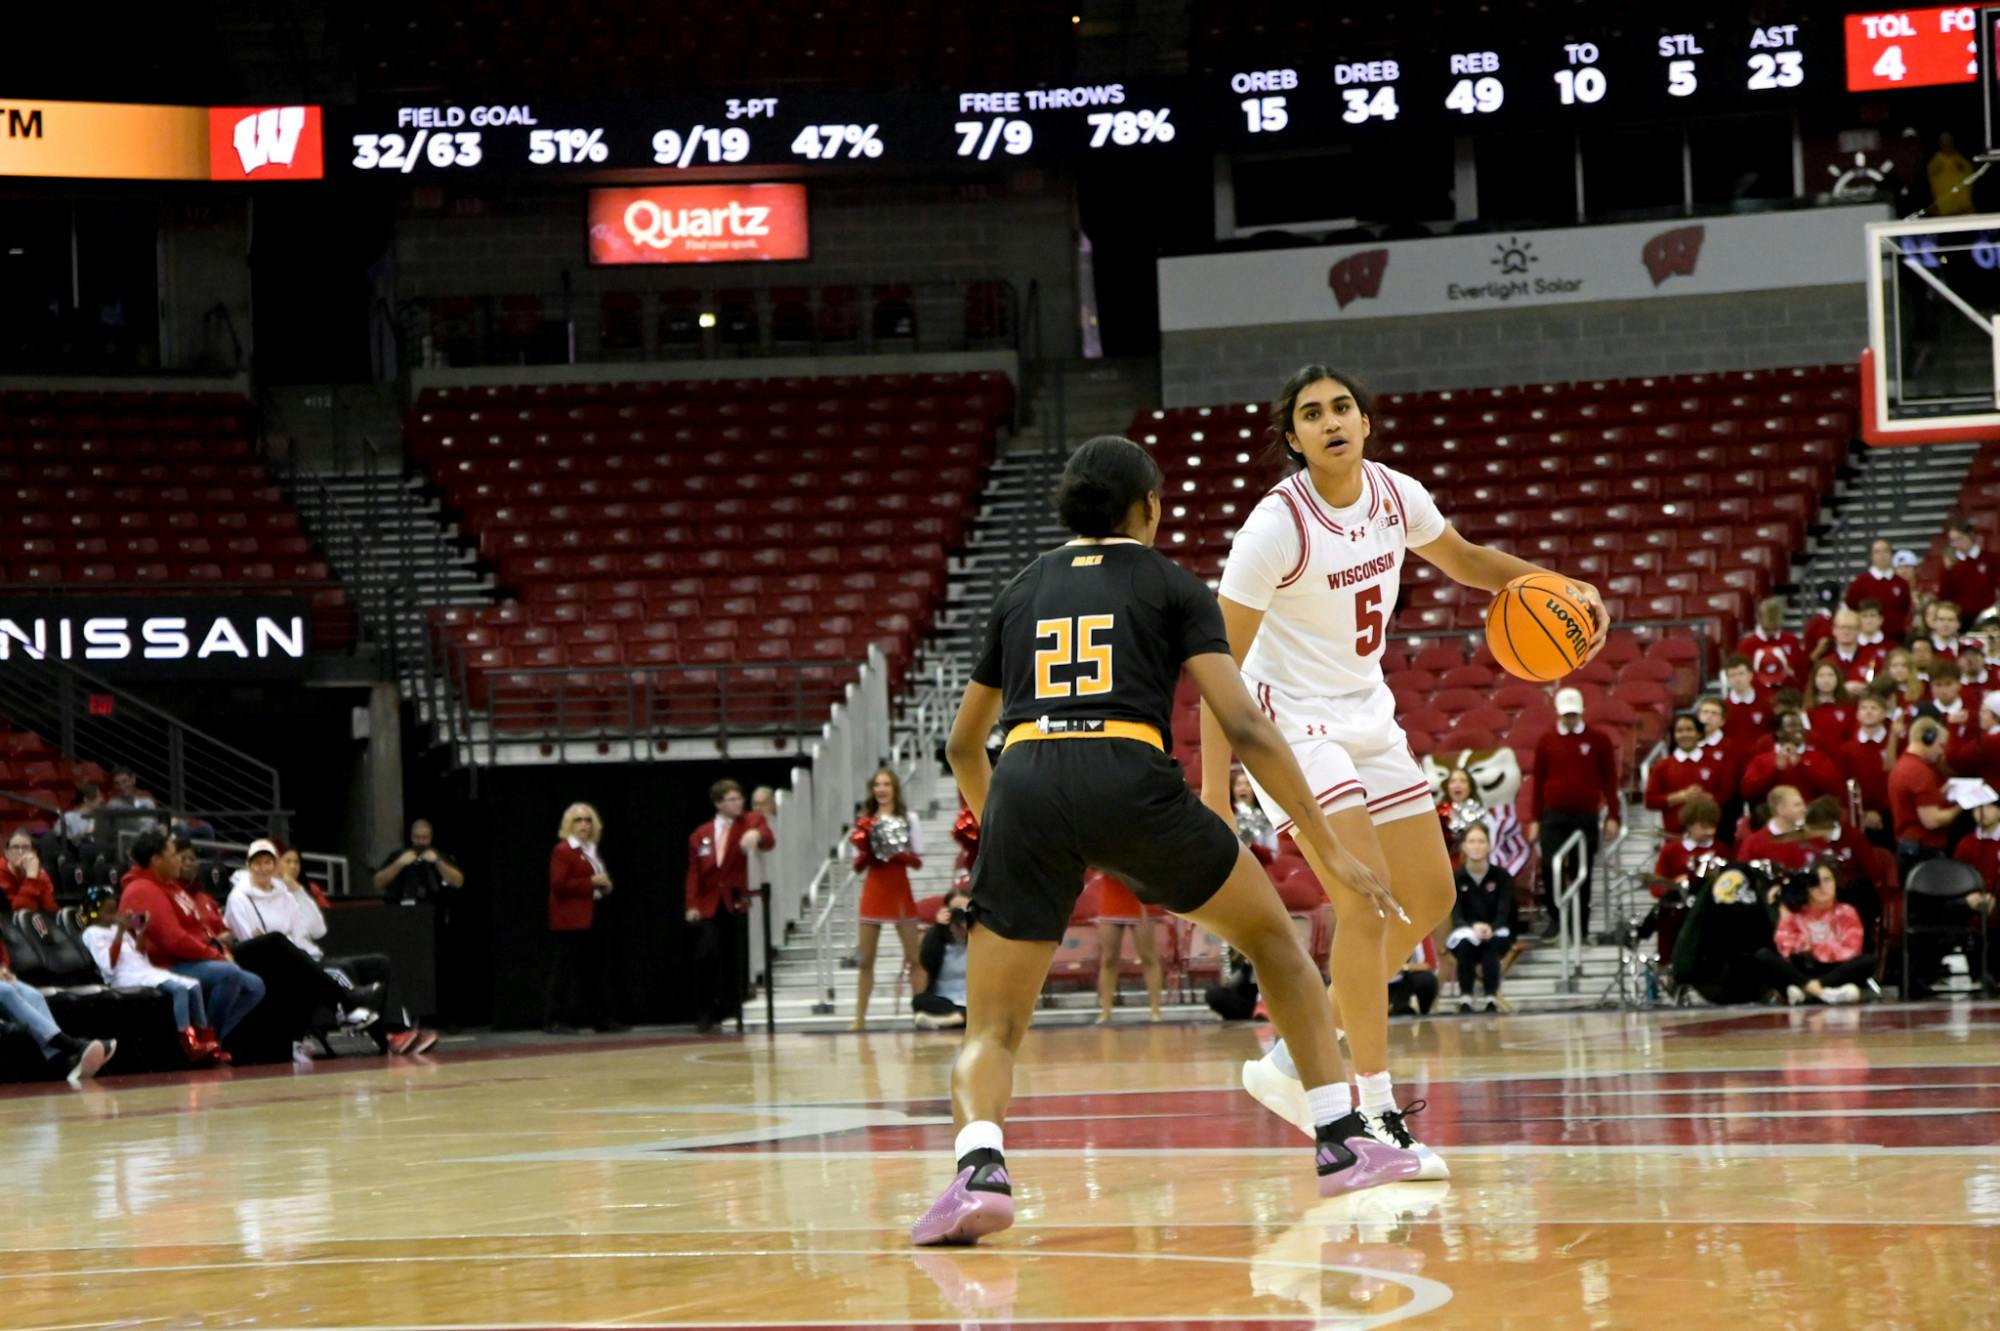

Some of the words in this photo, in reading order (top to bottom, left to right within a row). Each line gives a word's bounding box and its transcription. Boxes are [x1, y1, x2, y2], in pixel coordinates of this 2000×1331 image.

[1750, 25, 1798, 49] AST
[1862, 15, 1916, 39] TOL
[1450, 52, 1500, 75] REB
[1564, 43, 1599, 65] TO
[1658, 34, 1703, 57] STL
[1873, 46, 1906, 81] 4
[1231, 70, 1298, 94] OREB
[1334, 61, 1400, 85] DREB
[1554, 67, 1607, 104] 10
[1668, 61, 1697, 97] 5
[1747, 51, 1804, 90] 23
[725, 98, 778, 120] 3-PT
[959, 92, 1020, 113] FREE
[1025, 84, 1126, 111] THROWS
[1342, 86, 1400, 124] 34
[1445, 77, 1504, 115] 49
[0, 109, 43, 139] M
[398, 107, 466, 128] FIELD
[470, 105, 538, 127] GOAL
[1241, 97, 1289, 133] 15
[352, 130, 483, 173] 32/63
[528, 129, 609, 165] 51%
[652, 125, 751, 168] 9/19
[791, 124, 884, 159] 47%
[954, 117, 1034, 161] 7/9
[1087, 109, 1175, 148] 78%
[624, 199, 769, 248] Quartz
[1447, 281, 1530, 300] Everlight
[1534, 278, 1584, 294] Solar
[1326, 551, 1396, 590] WISCONSIN
[0, 616, 304, 660] NISSAN
[1355, 583, 1383, 657] 5
[1545, 598, 1588, 660] Wilson
[1035, 613, 1115, 700] 25
